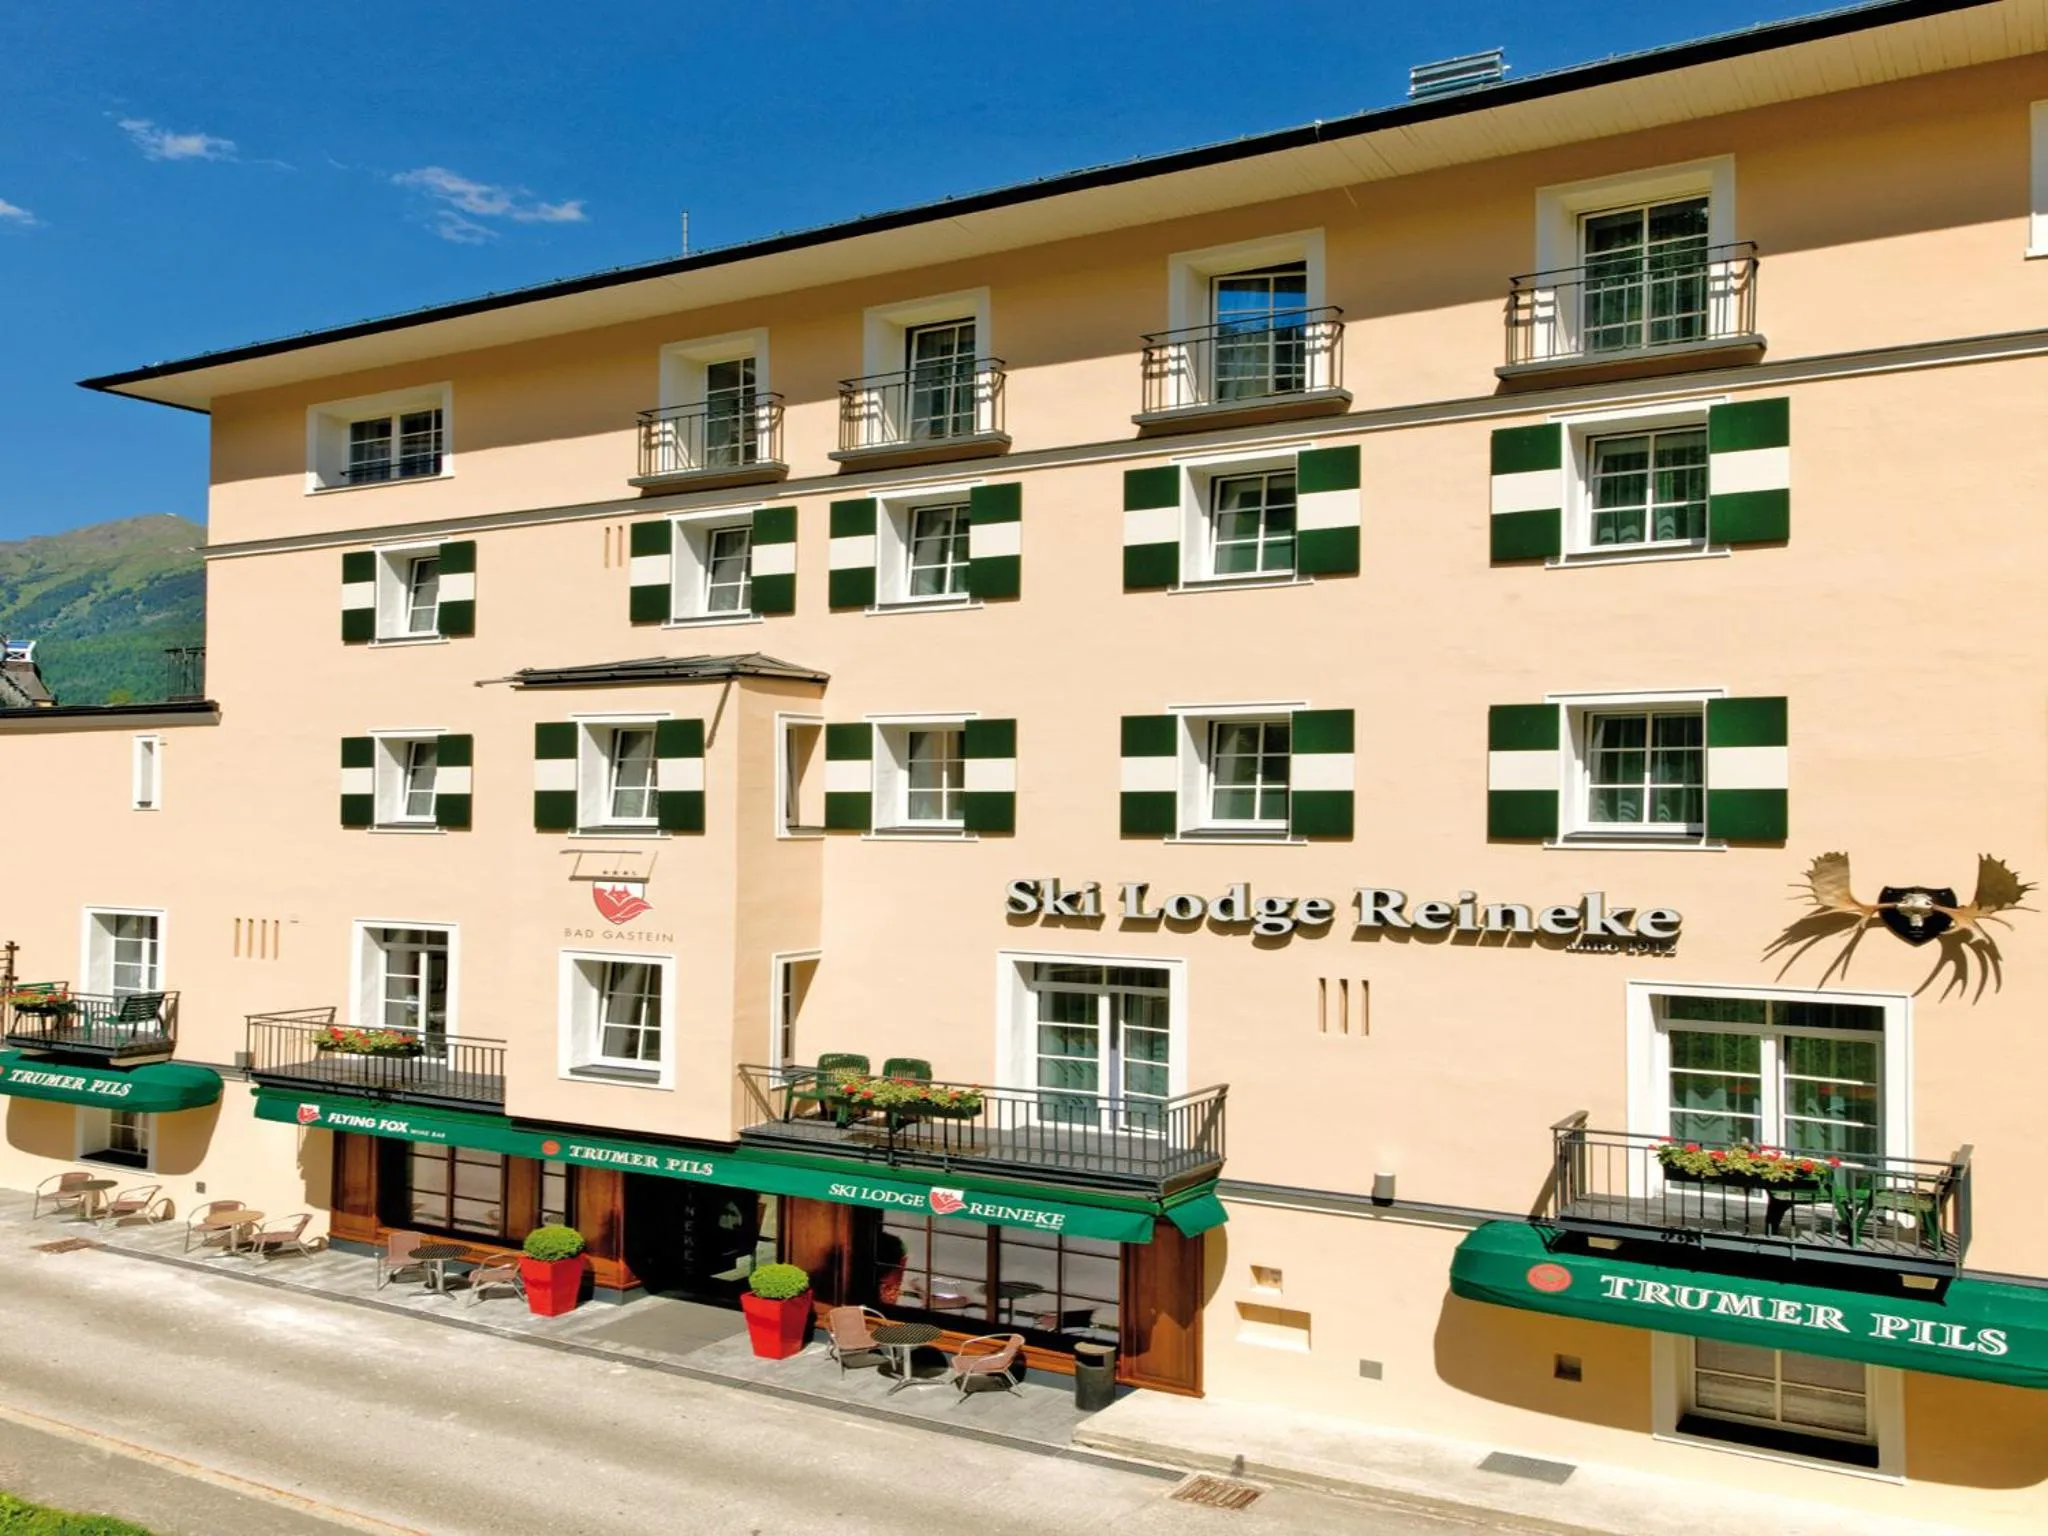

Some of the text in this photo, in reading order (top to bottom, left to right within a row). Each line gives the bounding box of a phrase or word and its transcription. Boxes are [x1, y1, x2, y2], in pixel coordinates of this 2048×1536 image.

[1005, 877, 1683, 941] Ski Lodge Reineke
[564, 928, 674, 943] BAD GASTEIN
[8, 1069, 133, 1097] TRUMER PILS
[327, 1112, 409, 1133] FLYING FOX
[569, 1145, 713, 1176] TRUMER PILS
[828, 1183, 1066, 1226] SKI LODGE REINEKE
[1600, 1274, 2009, 1356] TRUMER PILS
